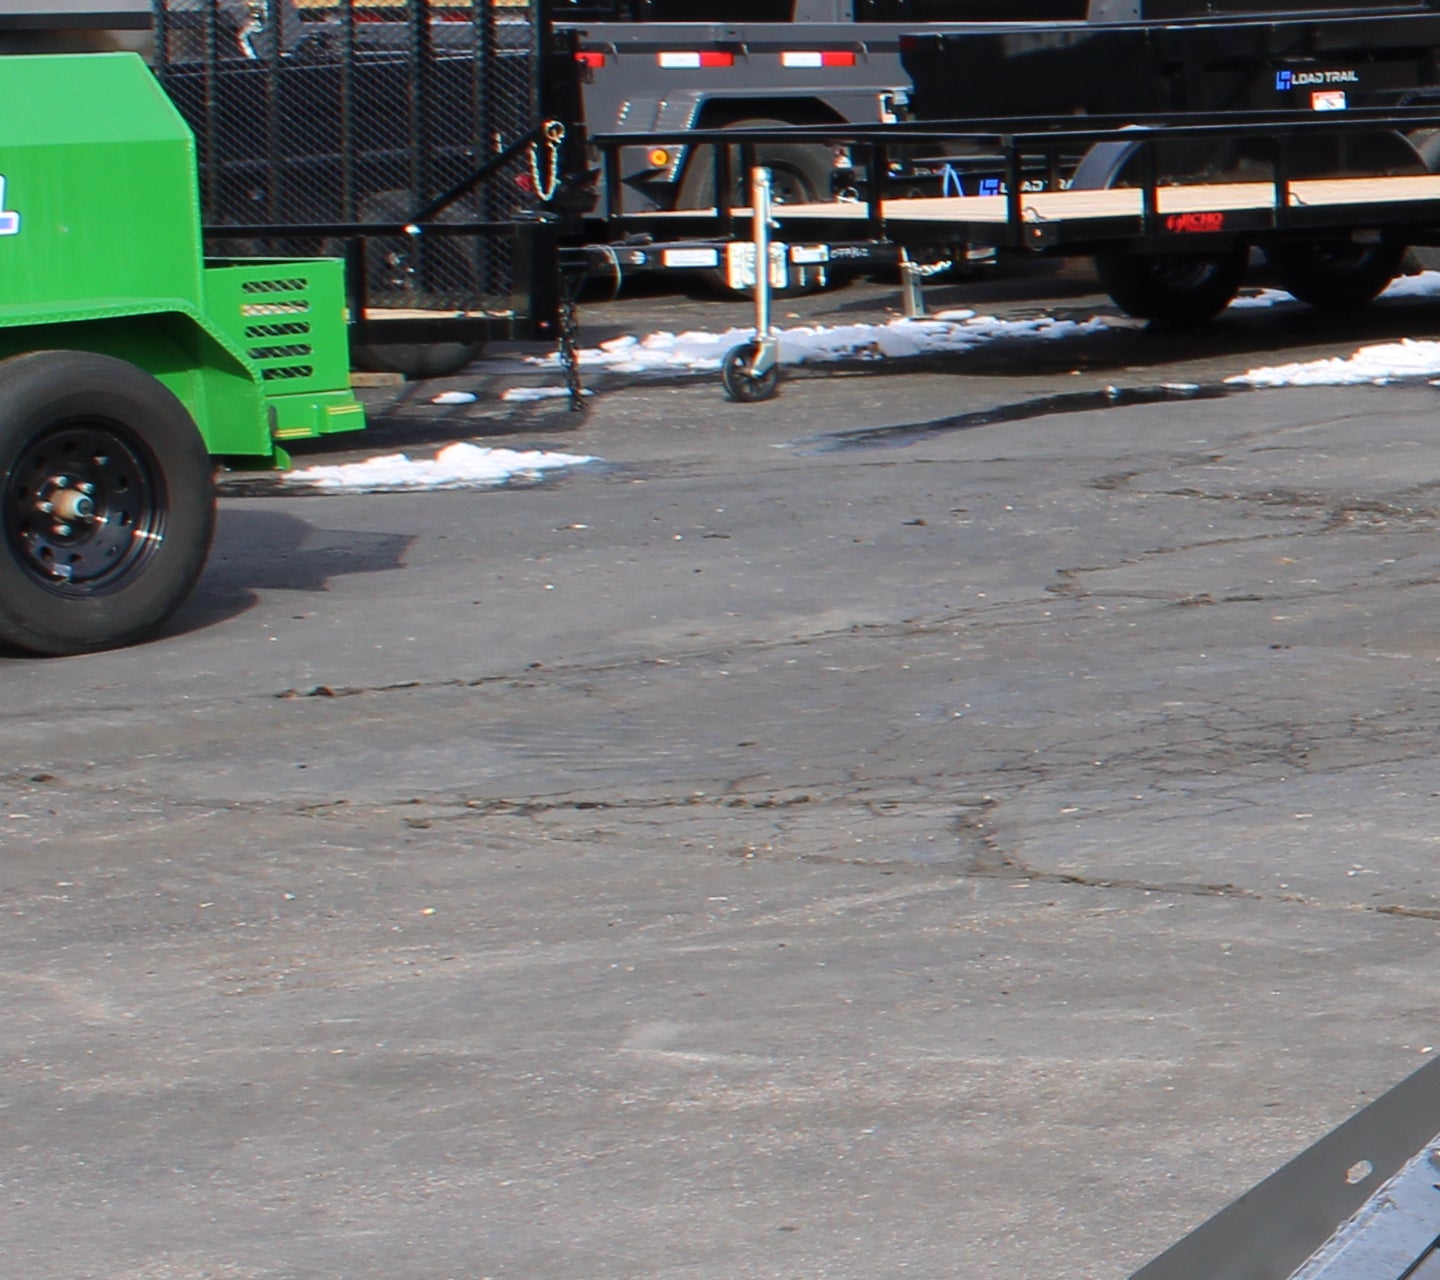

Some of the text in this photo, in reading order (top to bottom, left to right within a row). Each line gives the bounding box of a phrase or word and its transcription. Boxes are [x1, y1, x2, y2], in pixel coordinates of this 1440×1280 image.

[1292, 70, 1359, 85] LOAD TRAIL
[1000, 180, 1044, 194] LAD
